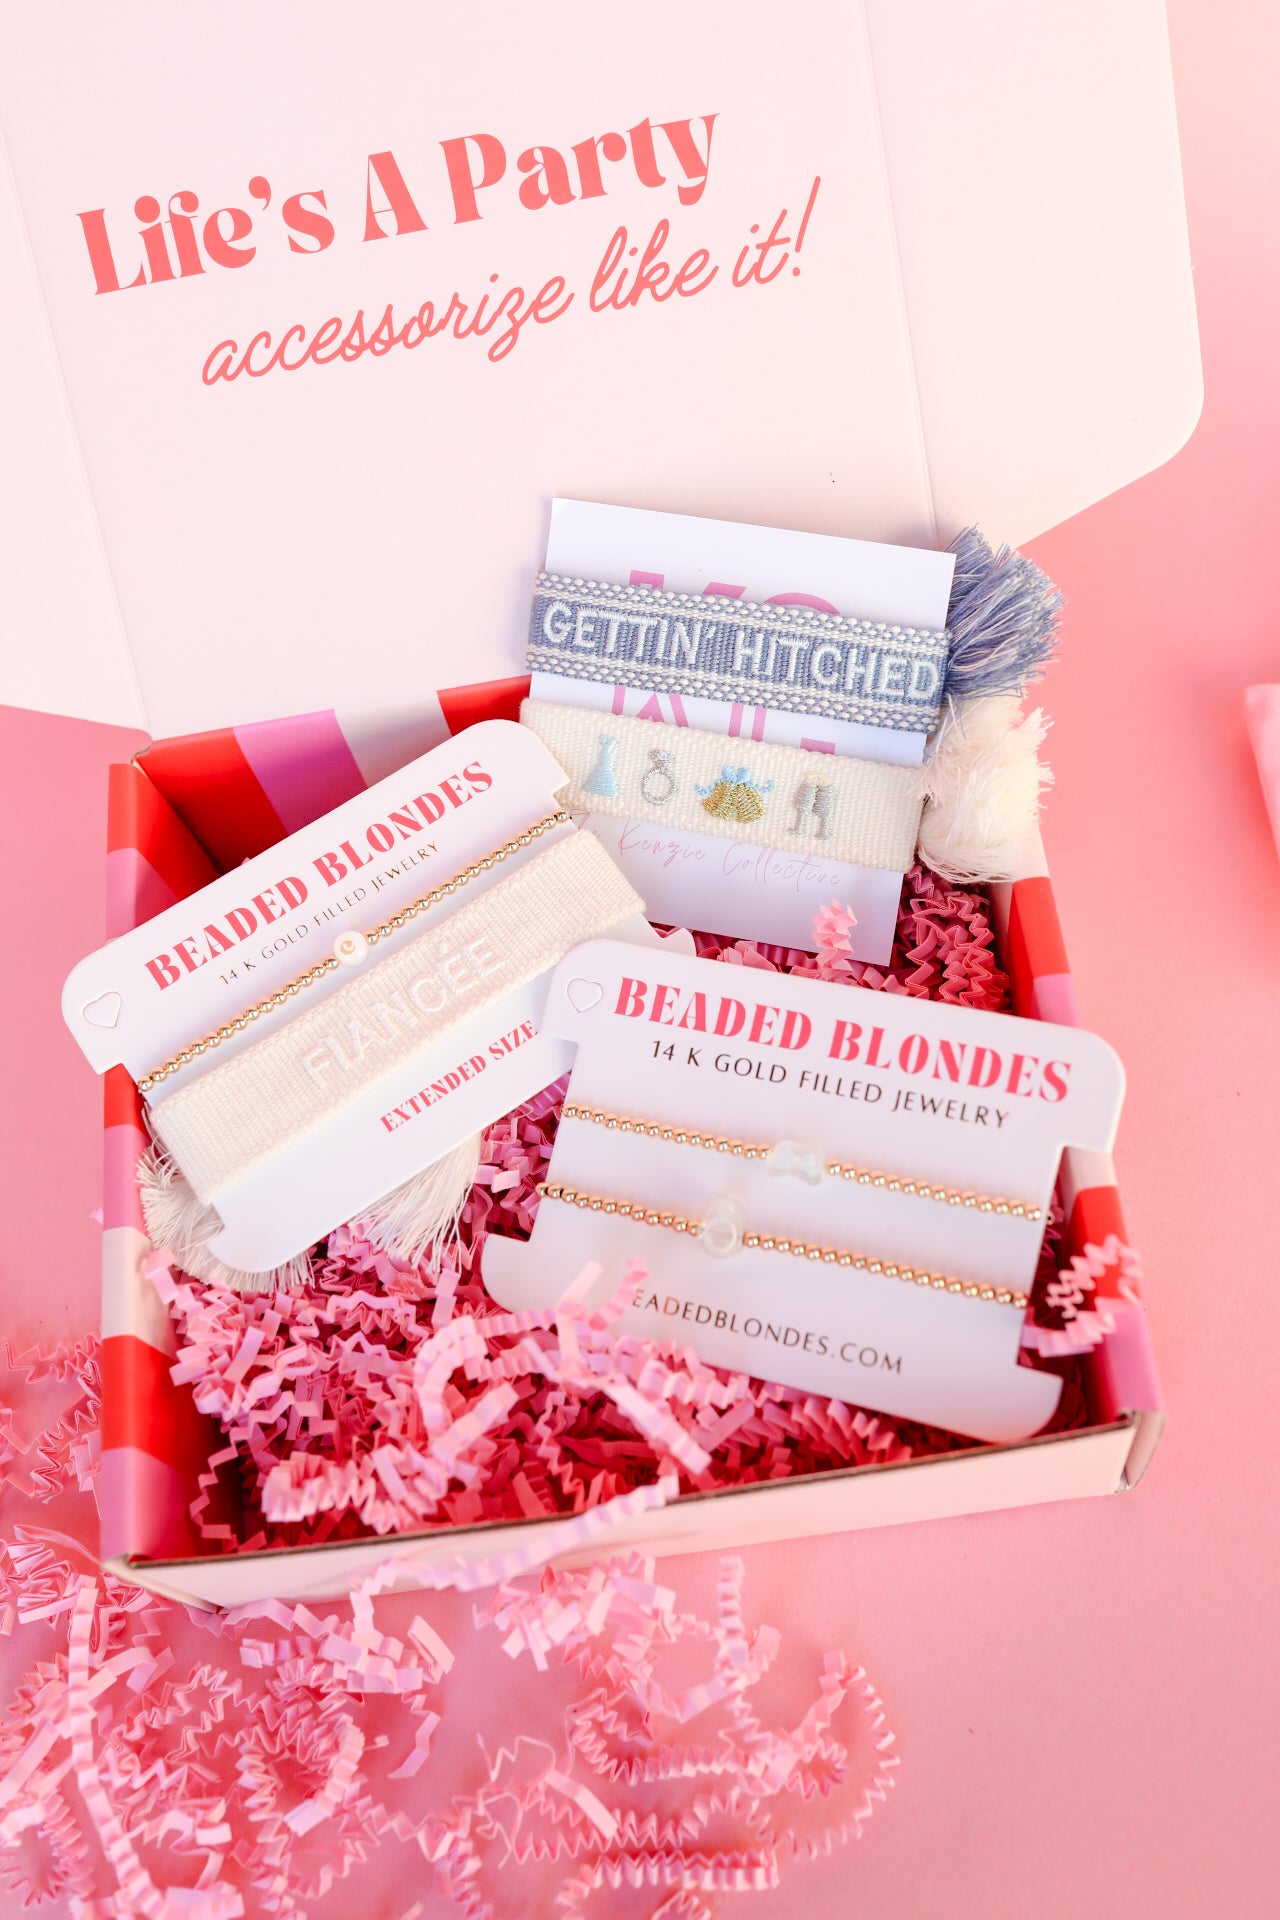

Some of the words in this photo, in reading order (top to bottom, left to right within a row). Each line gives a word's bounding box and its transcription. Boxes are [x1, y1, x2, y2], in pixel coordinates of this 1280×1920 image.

[76, 175, 335, 295] Life's
[361, 151, 429, 242] A
[438, 113, 721, 225] Party
[202, 273, 574, 385] accessorize
[589, 219, 719, 313] like
[732, 176, 821, 287] it!
[543, 601, 714, 662] GETTIN'
[734, 630, 939, 700] HITCHED
[144, 874, 309, 992] BEADED
[311, 761, 494, 887] BLONDES
[219, 967, 239, 986] 14
[242, 956, 257, 971] K
[261, 923, 309, 960] GOLD
[313, 886, 369, 928] FILLED
[370, 840, 440, 893] JEWELRY
[301, 930, 504, 1090] FIANCÉE
[379, 1053, 488, 1133] EXTENDED
[488, 1020, 538, 1063] SIZE
[614, 977, 812, 1051] BEADED
[828, 1019, 1071, 1103] BLONDES
[652, 1040, 676, 1062] 14
[687, 1048, 704, 1069] K
[715, 1054, 788, 1086] GOLD
[798, 1070, 882, 1104] FILLED
[891, 1088, 1010, 1130] JEWELRY
[630, 1289, 904, 1375] EADEDBLONDES.COM
